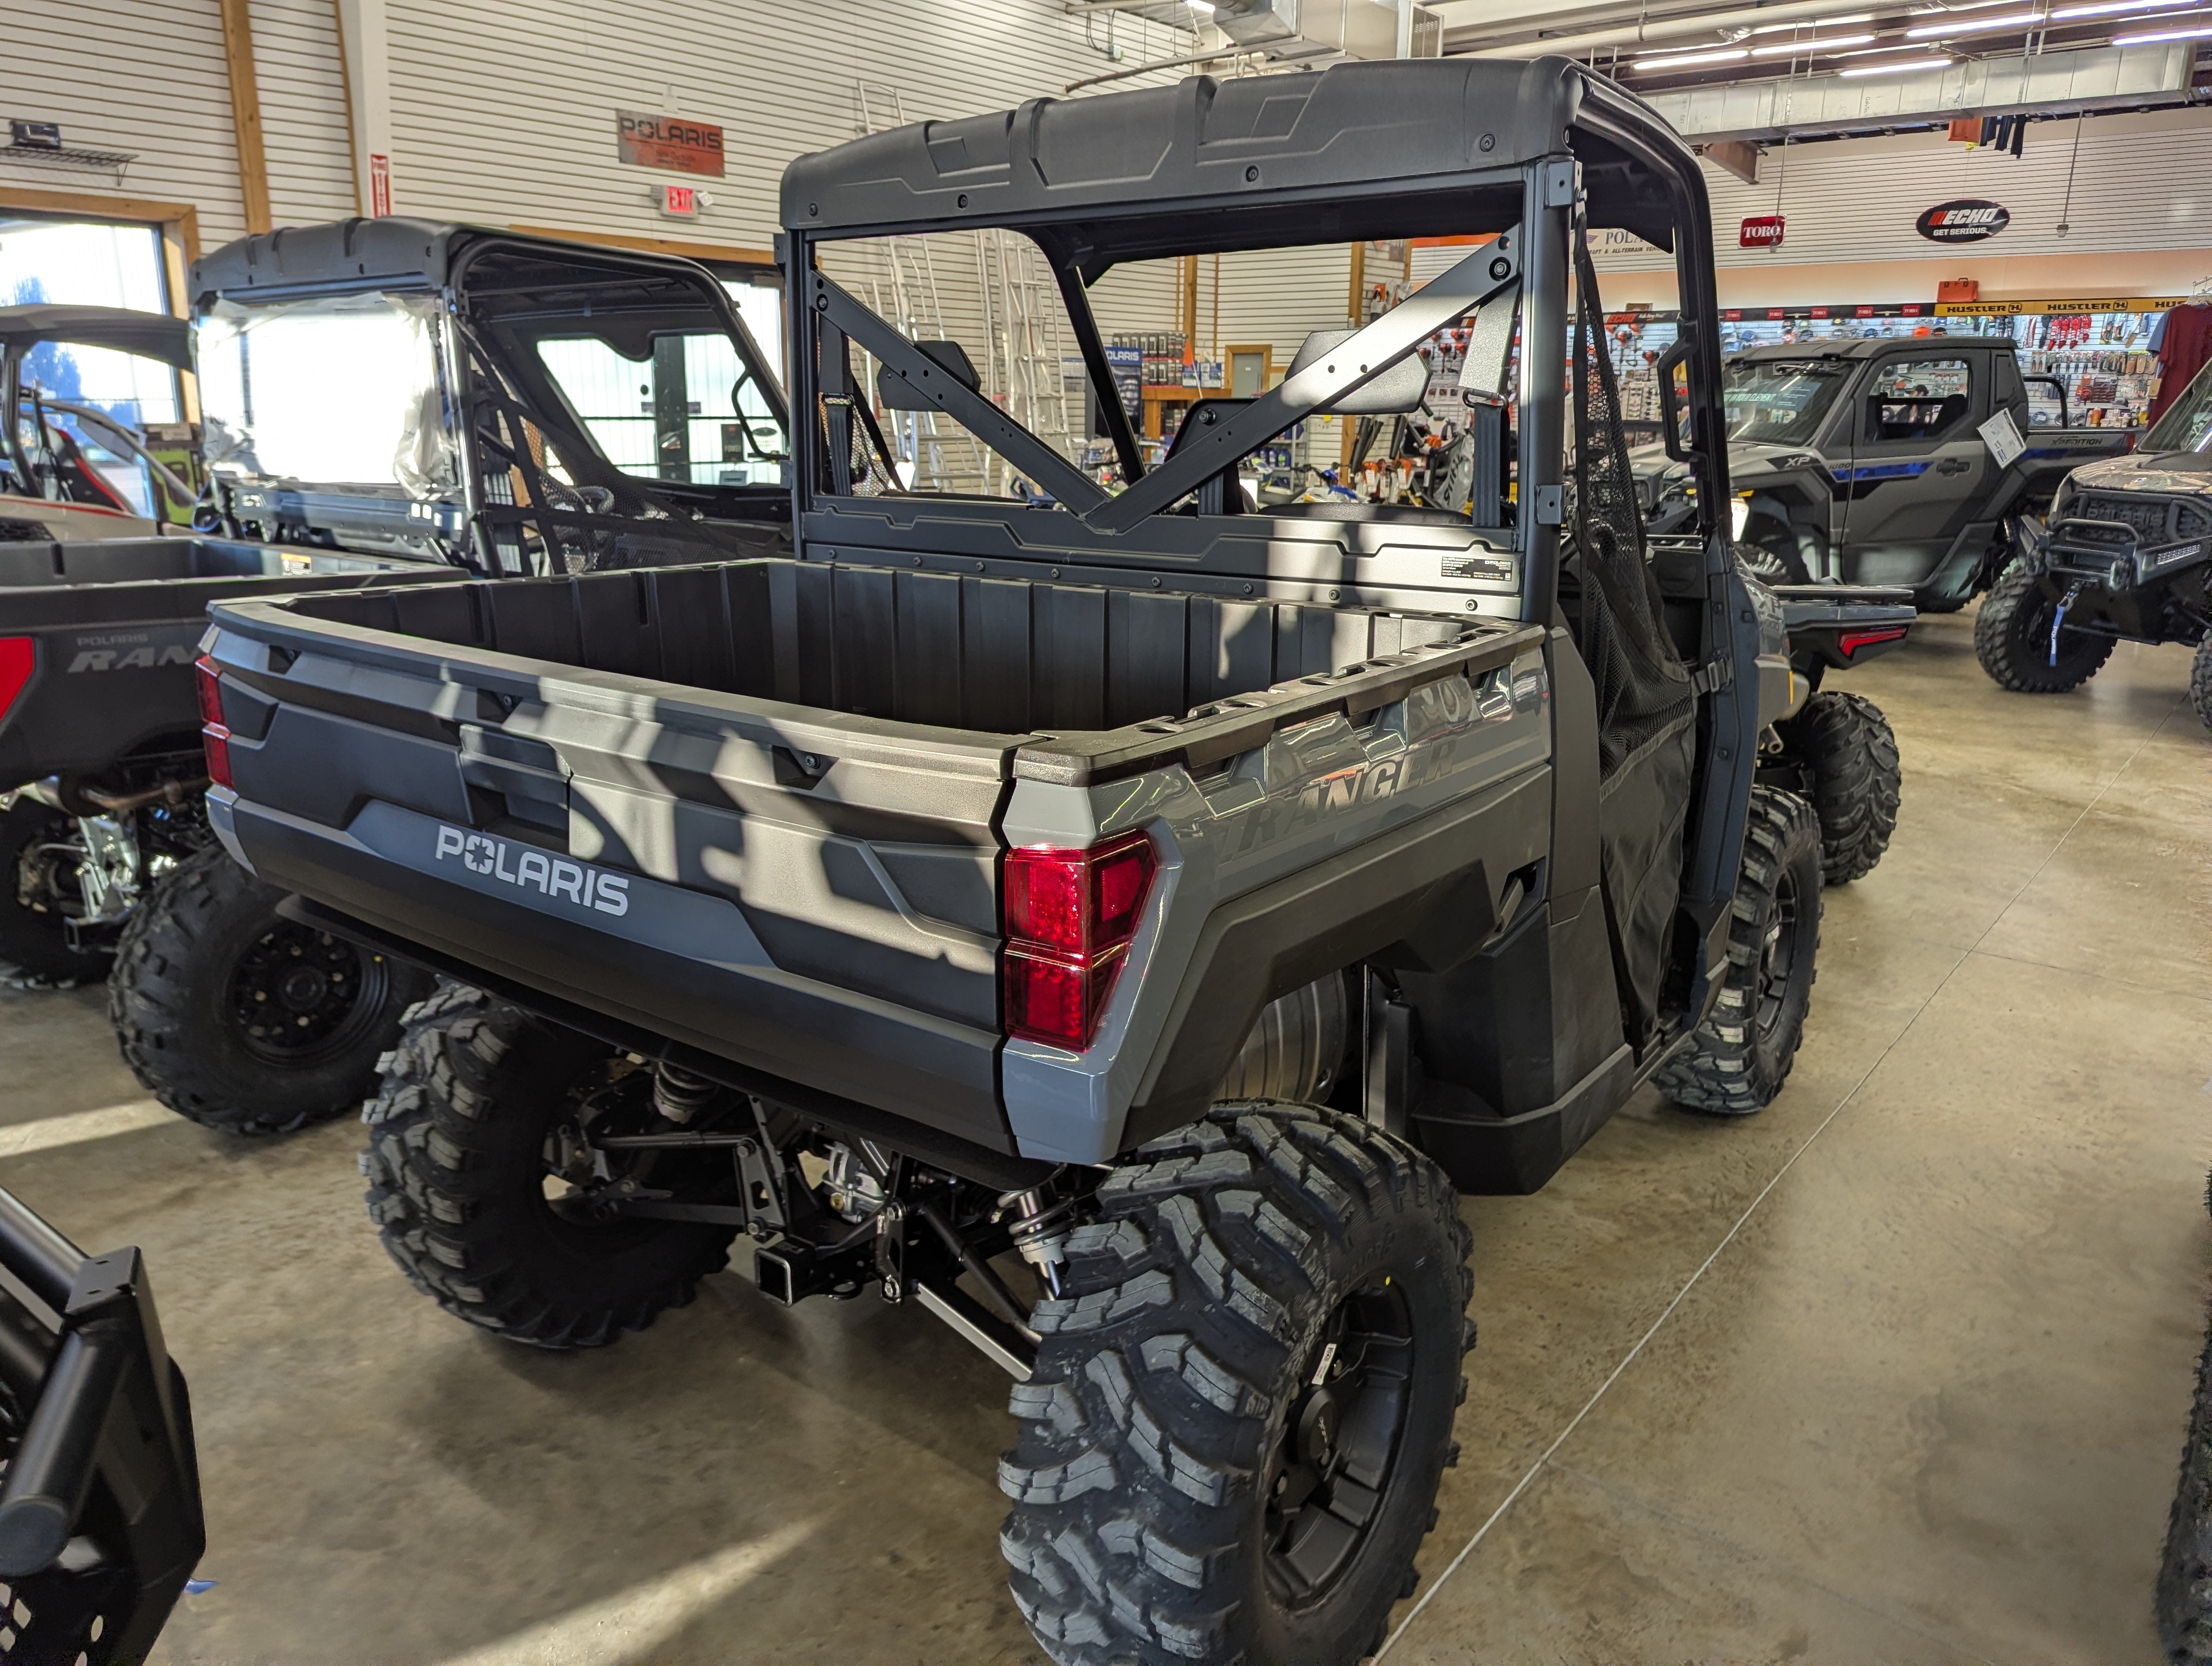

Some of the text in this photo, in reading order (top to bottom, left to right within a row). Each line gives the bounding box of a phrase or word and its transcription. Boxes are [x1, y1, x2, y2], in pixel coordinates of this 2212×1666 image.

[619, 117, 721, 150] POLARIS
[667, 186, 693, 214] EXIT
[1942, 208, 1998, 225] ECHO
[1743, 225, 1780, 238] TORO
[1946, 305, 2007, 313] HUSTLER
[2047, 303, 2111, 311] HUSTLER
[1609, 313, 1636, 323] ECHO
[1784, 456, 1811, 467] XP
[77, 633, 147, 646] POLARIS
[1238, 735, 1458, 853] RANGER
[435, 824, 629, 917] POLARIS
